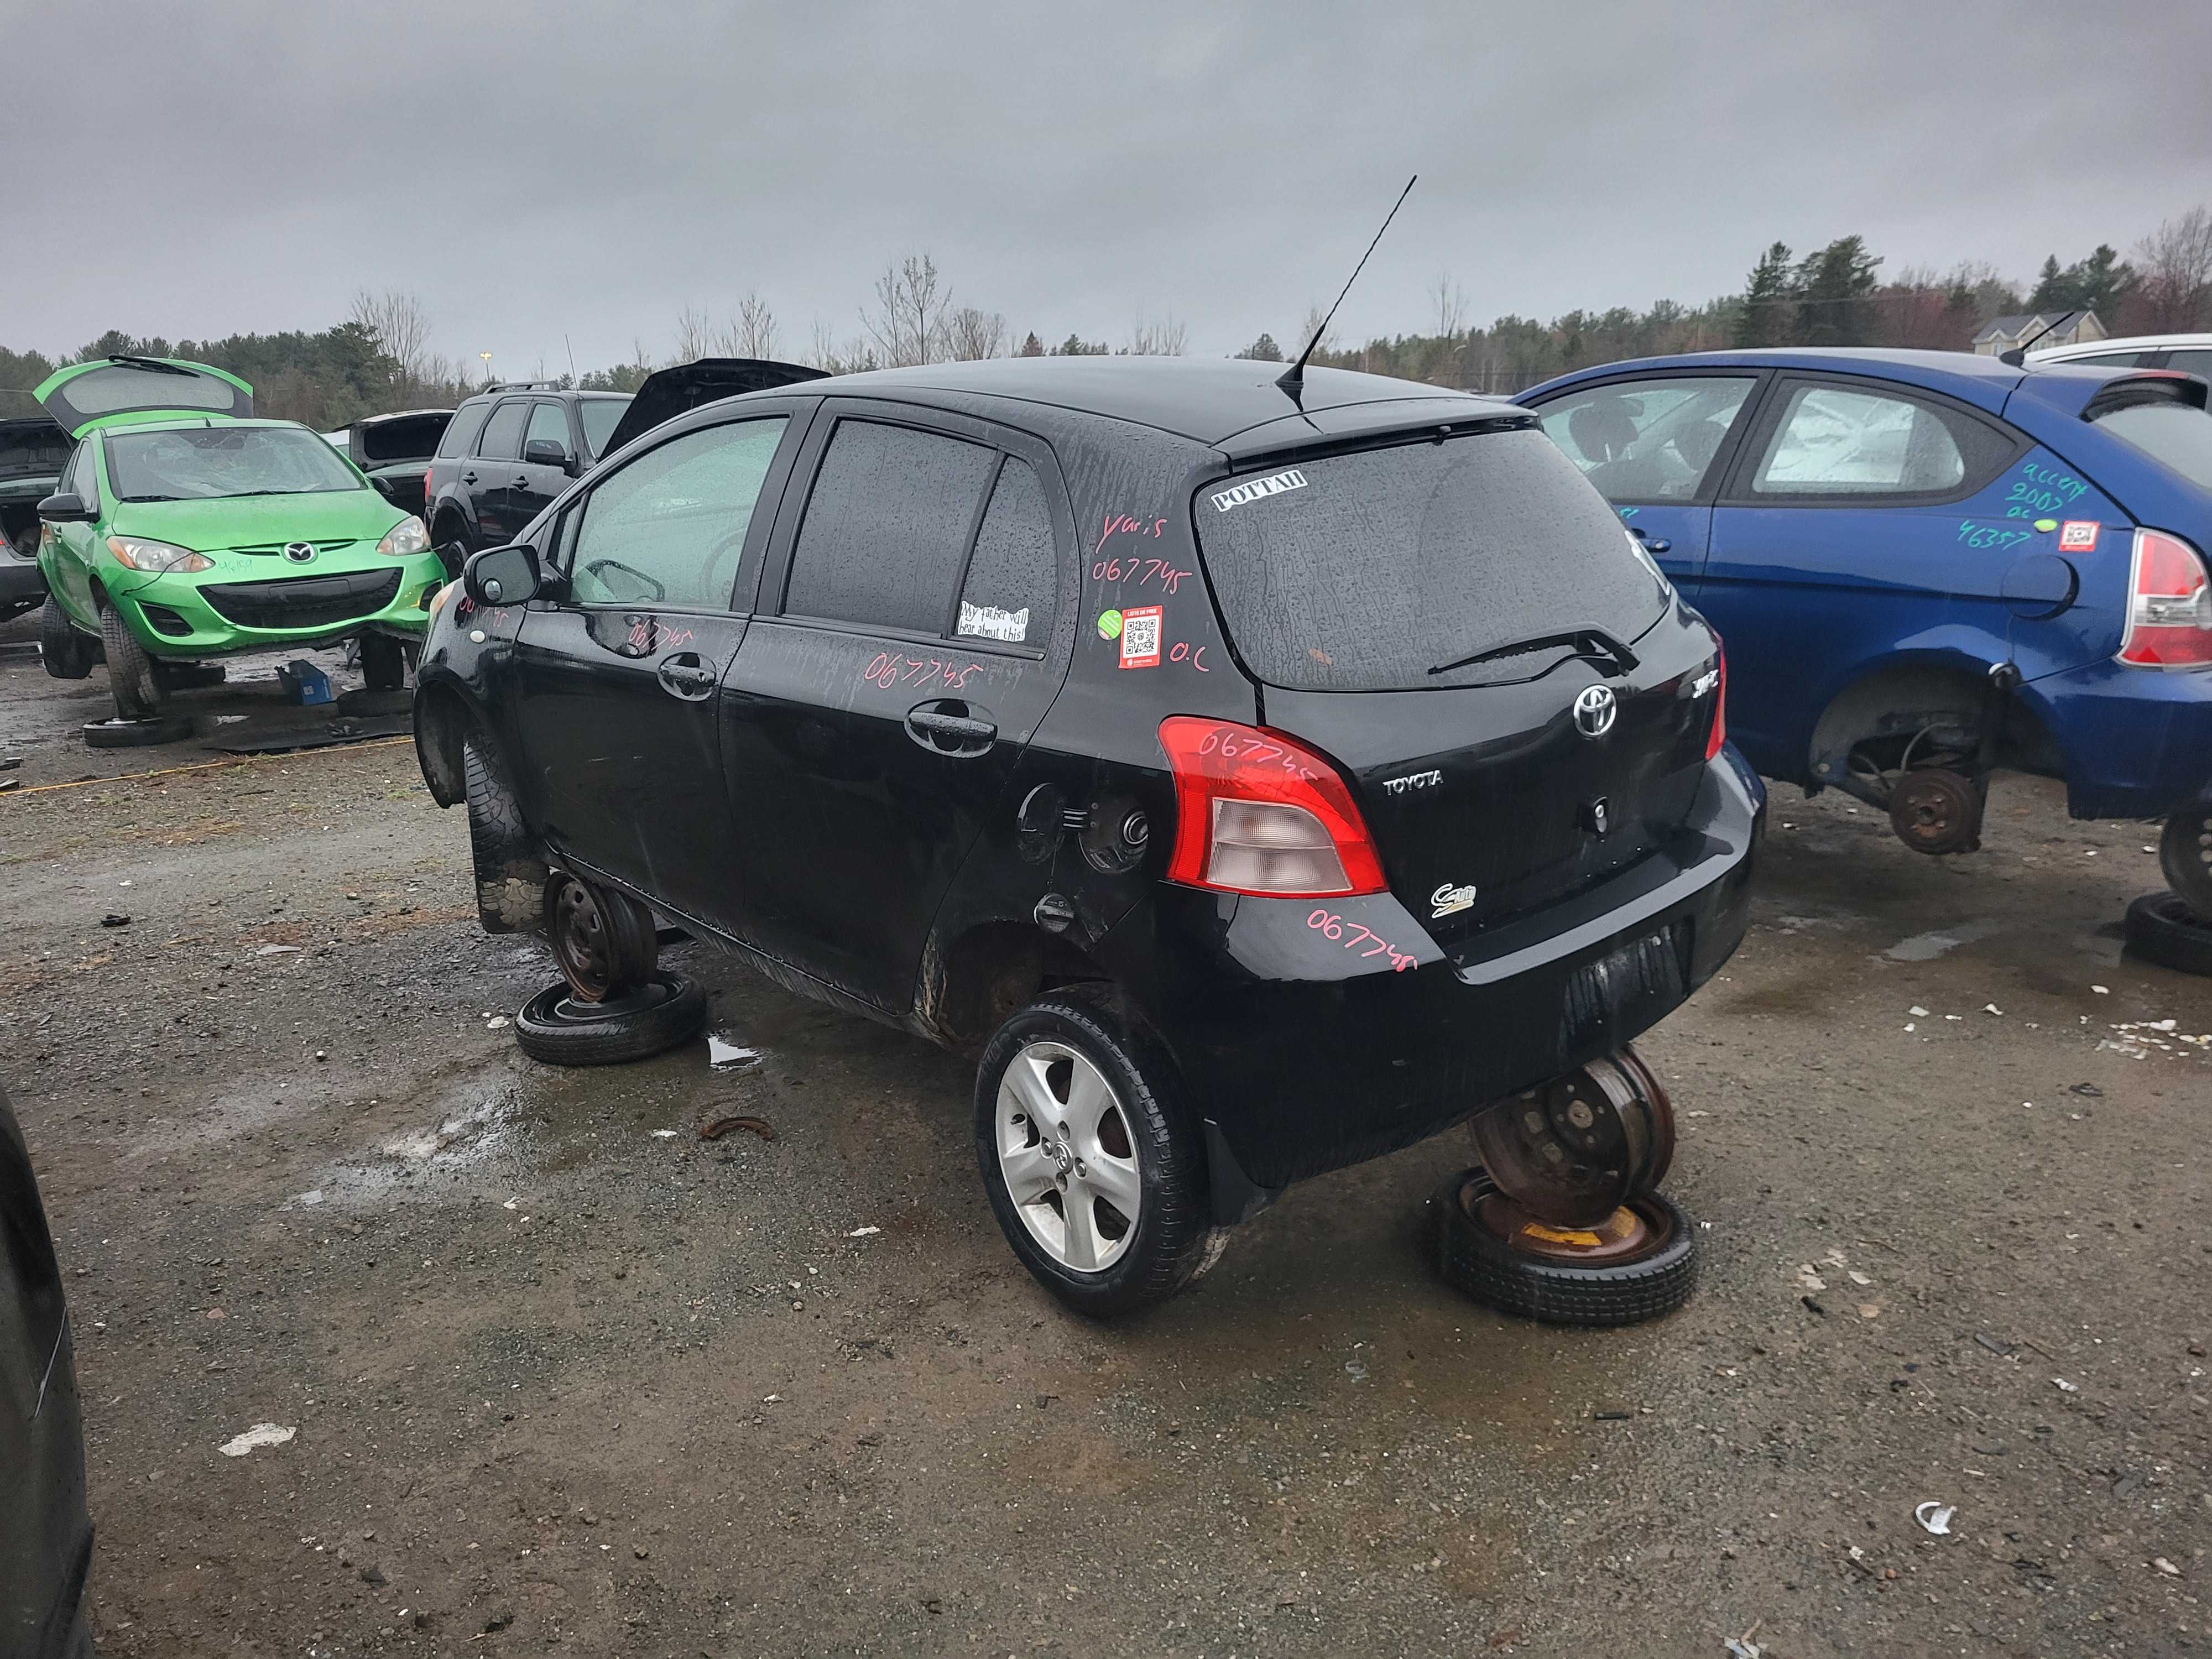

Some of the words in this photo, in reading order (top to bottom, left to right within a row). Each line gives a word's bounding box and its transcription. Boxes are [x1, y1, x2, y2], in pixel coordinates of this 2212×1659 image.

[1214, 471, 1305, 510] POTTAH
[2005, 482, 2062, 512] 2007
[1957, 520, 2031, 550] 46357
[1092, 557, 1193, 595] 067745
[961, 602, 979, 622] My
[981, 606, 1006, 622] father
[1010, 610, 1027, 625] will
[959, 620, 975, 634] hear
[978, 622, 1000, 639] about
[1004, 626, 1025, 642] this!
[865, 653, 983, 688] 067745
[1198, 733, 1319, 781] 067745
[1383, 770, 1444, 796] TOYOTA
